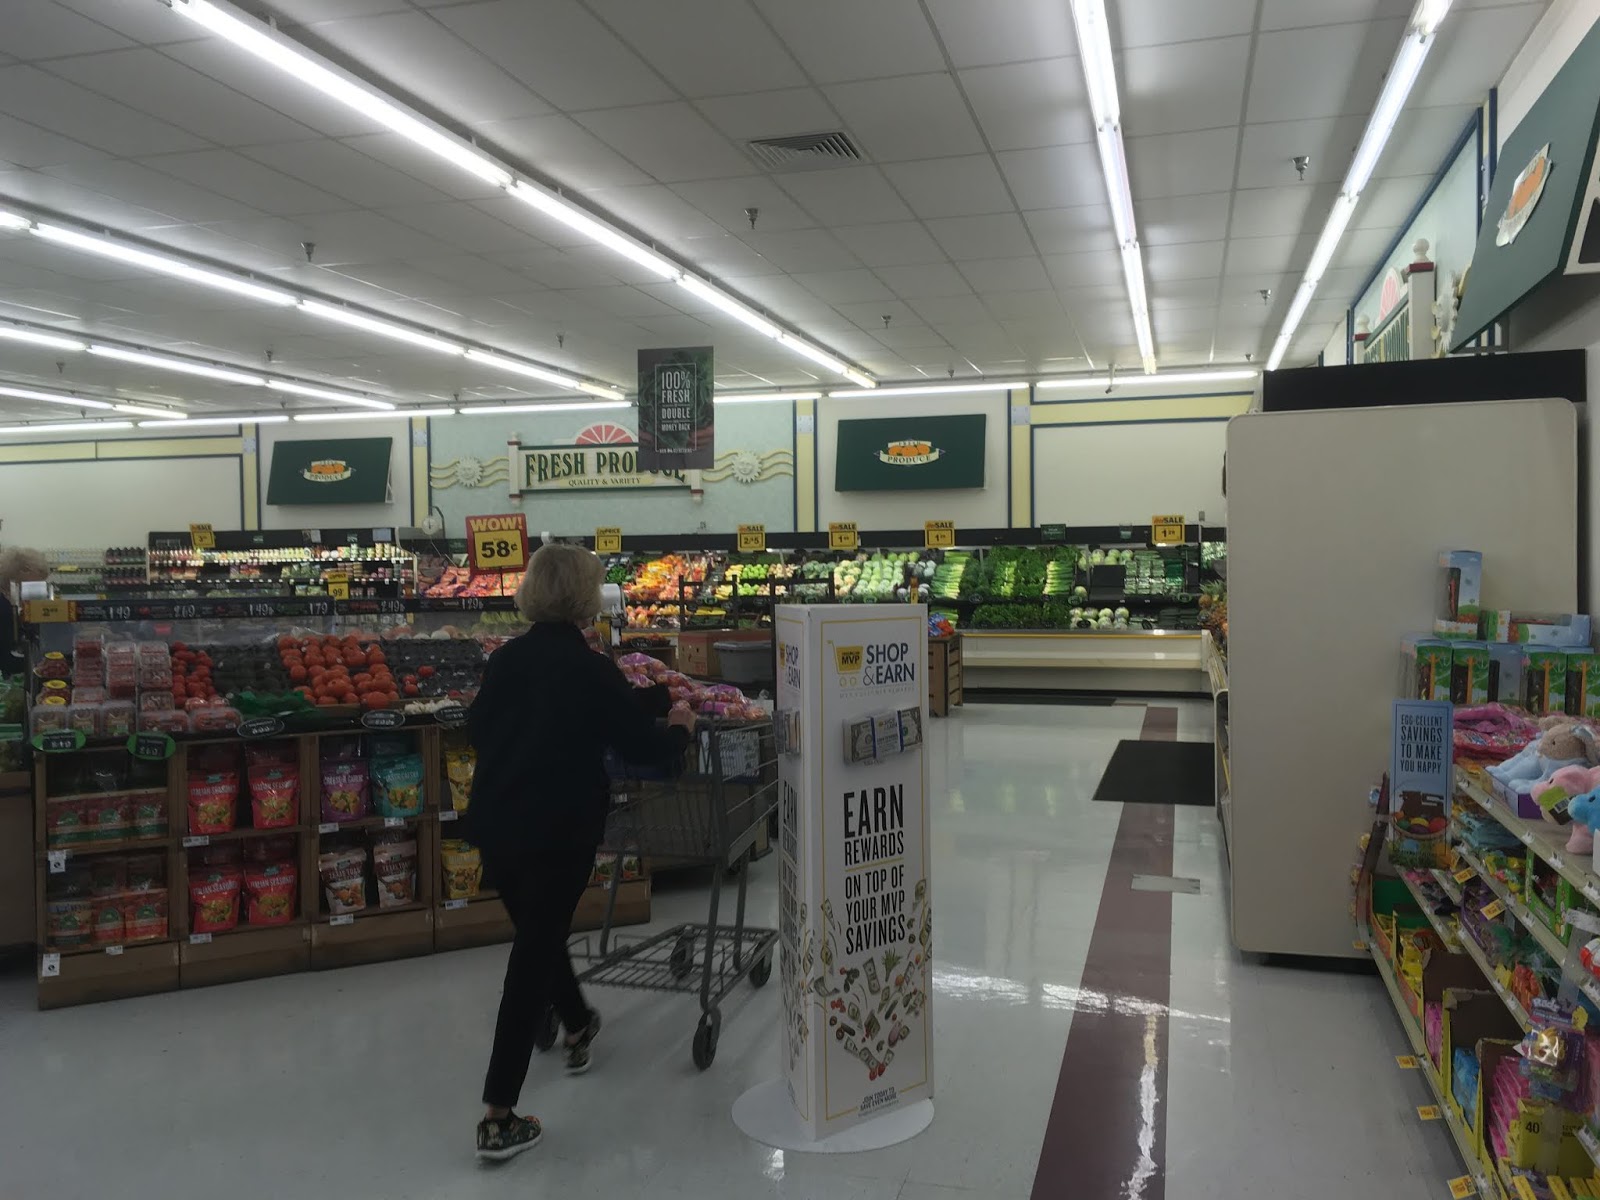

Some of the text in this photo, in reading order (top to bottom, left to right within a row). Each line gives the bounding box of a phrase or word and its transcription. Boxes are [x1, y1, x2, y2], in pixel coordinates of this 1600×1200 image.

[661, 371, 691, 390] 100%
[661, 390, 690, 403] FRESH
[661, 407, 691, 419] DOUBLE
[661, 423, 691, 432] MONEY BACK
[887, 456, 931, 464] PRODUCE
[525, 452, 586, 488] FRESH
[568, 477, 600, 488] QUALITY
[610, 477, 641, 486] VARIETY
[469, 516, 523, 533] WOW!
[838, 523, 857, 531] SALE
[934, 521, 954, 529] SALE
[1164, 516, 1184, 524] SALE
[841, 656, 860, 665] MVP
[866, 643, 909, 665] SHOP
[1401, 726, 1443, 743] SAVINGS
[1401, 743, 1442, 761] TO MAKE
[1400, 759, 1442, 774] YOU HAPPY
[844, 783, 904, 839] EARN
[844, 830, 904, 867] REWARDS
[845, 864, 905, 899] ON TOP OF
[845, 890, 905, 925] YOUR MVP
[845, 913, 906, 956] SAVINGS
[1525, 1121, 1540, 1135] 40
